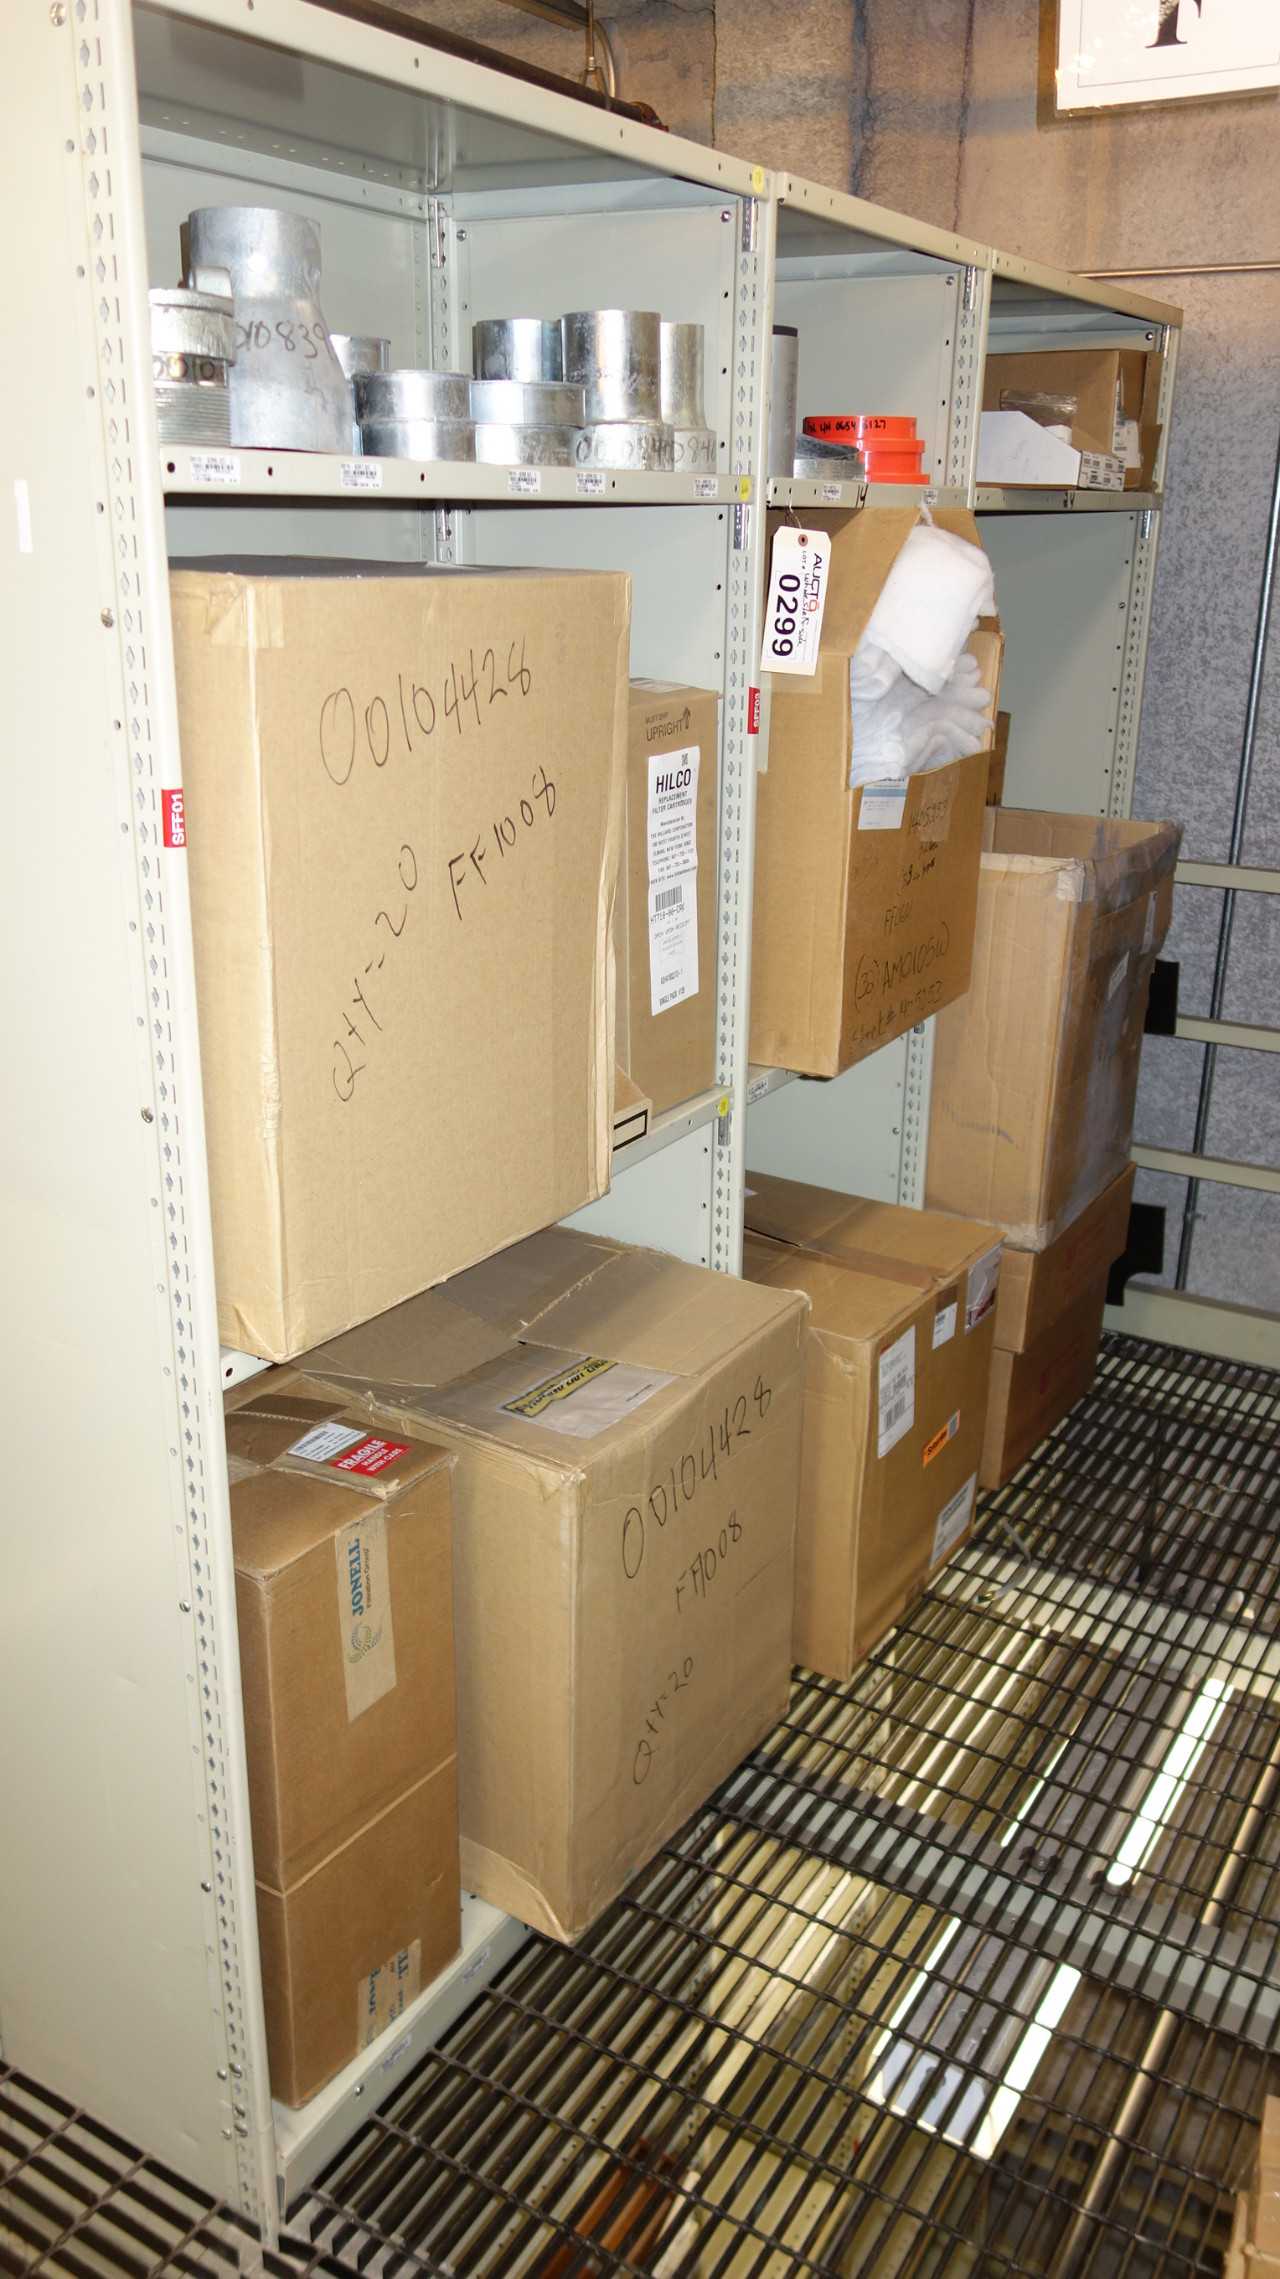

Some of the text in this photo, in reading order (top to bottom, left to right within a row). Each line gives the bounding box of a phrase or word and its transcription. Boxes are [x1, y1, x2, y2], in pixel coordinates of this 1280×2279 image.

[771, 574, 801, 656] 0299
[320, 640, 532, 785] 00104428
[646, 718, 684, 742] UPRIGHT
[170, 793, 185, 846] SFF01
[655, 768, 692, 794] HILCO
[448, 766, 557, 920] FF1008
[337, 1439, 388, 1471] FRAGILE
[622, 1375, 772, 1580] 00104428
[348, 1537, 365, 1617] JONELL
